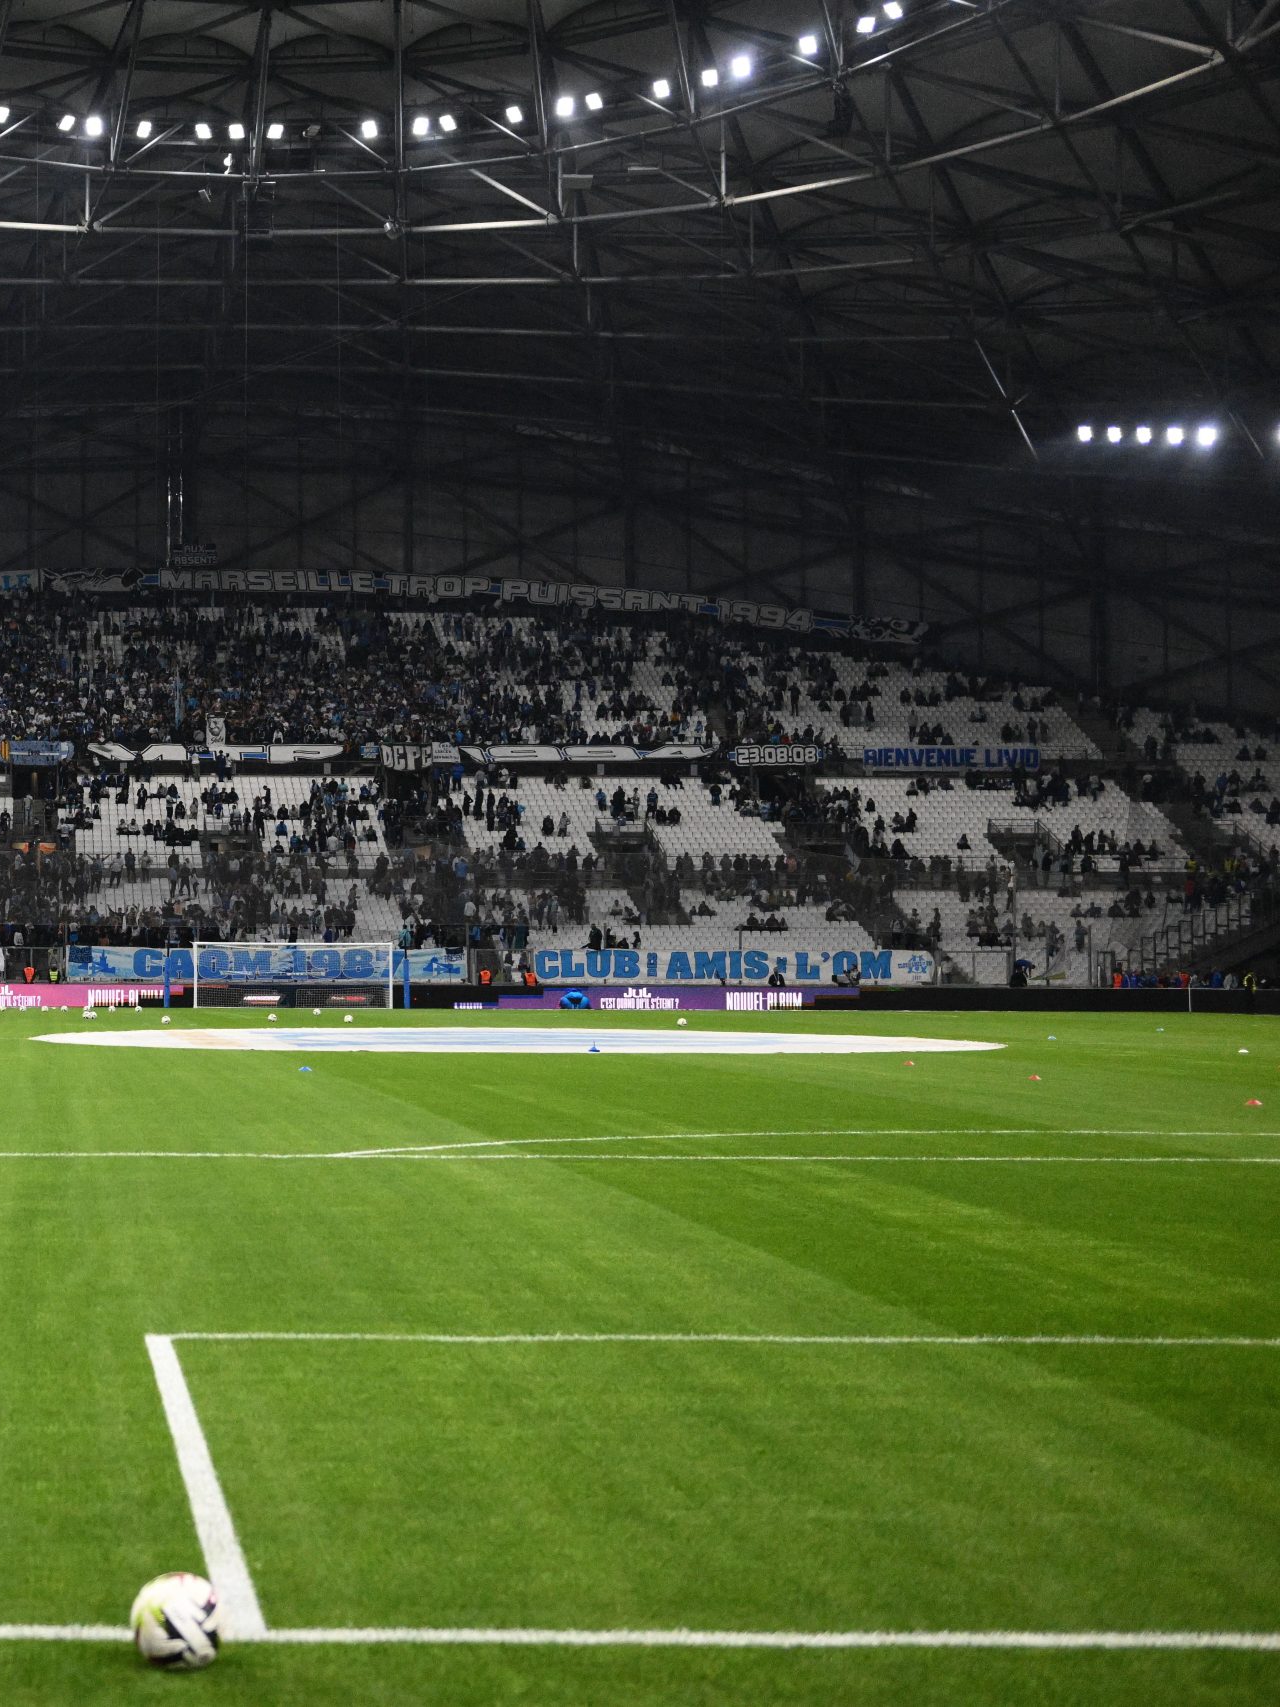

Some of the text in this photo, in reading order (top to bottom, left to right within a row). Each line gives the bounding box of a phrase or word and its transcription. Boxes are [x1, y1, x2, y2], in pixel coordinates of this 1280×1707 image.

[158, 568, 374, 593] MARSEILLE
[384, 572, 492, 599] TROP
[502, 578, 708, 614] PUISSANT
[865, 748, 978, 768] BIENVENUE
[133, 949, 273, 979] CAOM
[535, 950, 641, 980] CLUB
[666, 951, 769, 979] AMIS
[795, 950, 893, 980] L'OM
